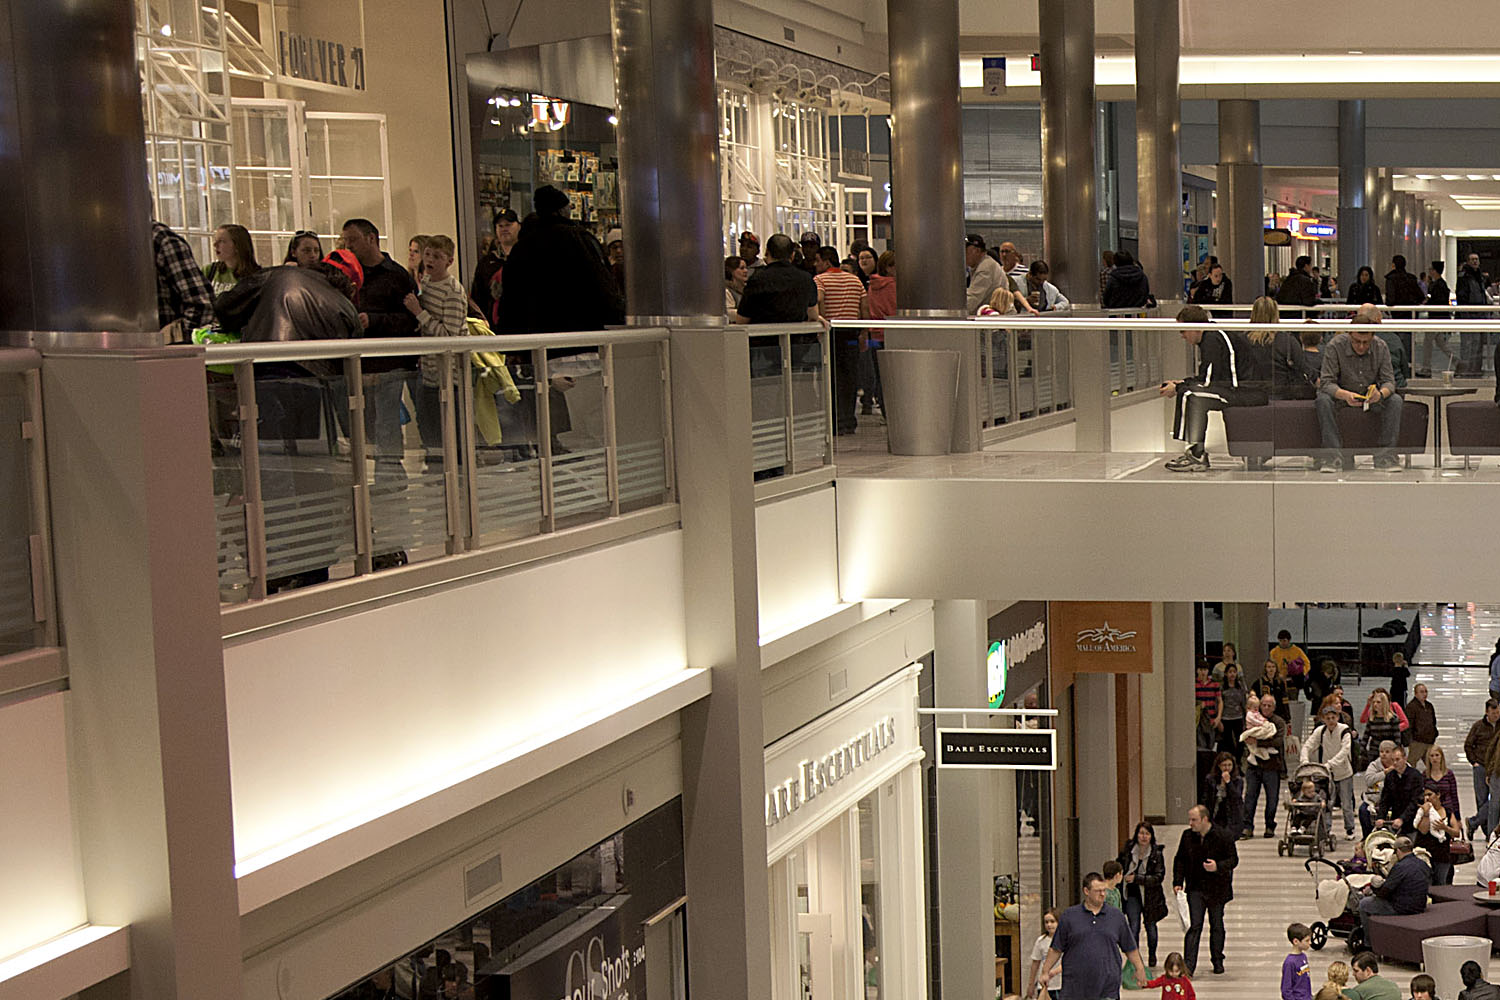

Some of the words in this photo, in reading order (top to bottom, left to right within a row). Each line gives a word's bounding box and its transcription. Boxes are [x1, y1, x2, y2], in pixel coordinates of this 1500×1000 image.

[1103, 641, 1137, 652] AMERICA
[946, 745, 975, 753] BARE
[978, 745, 1048, 753] ESCENTUALS
[765, 776, 800, 828] ARE
[601, 944, 631, 1000] Shots
